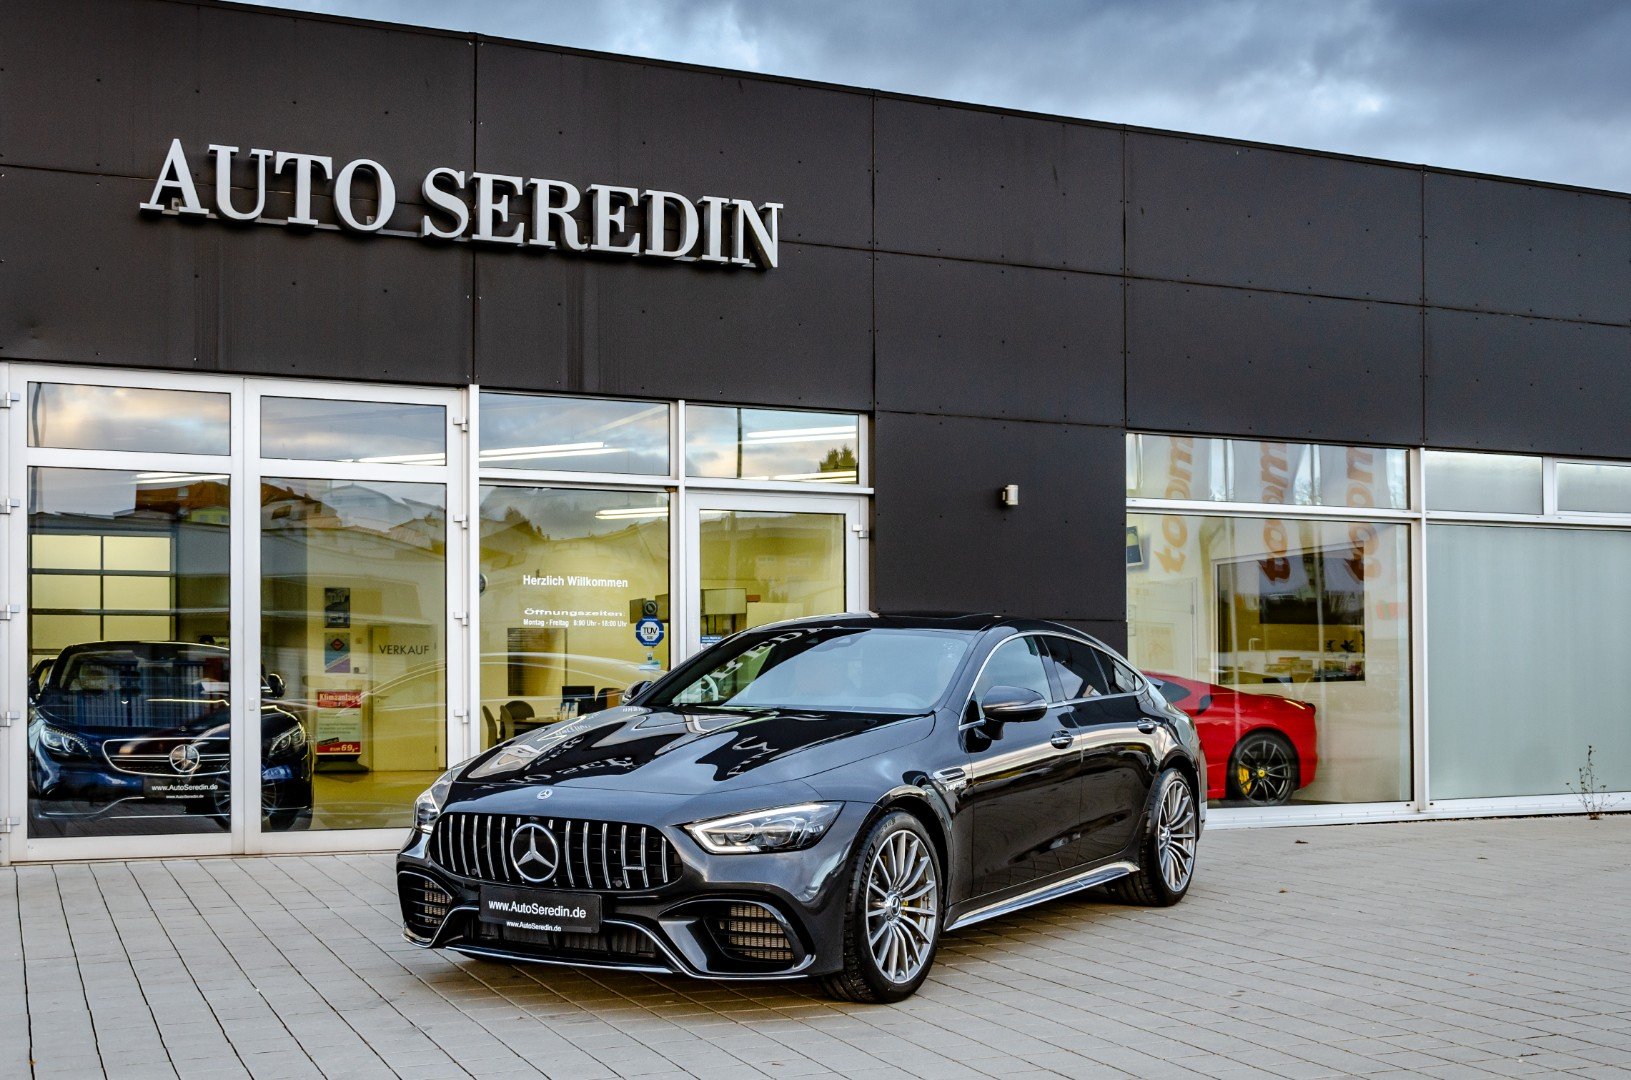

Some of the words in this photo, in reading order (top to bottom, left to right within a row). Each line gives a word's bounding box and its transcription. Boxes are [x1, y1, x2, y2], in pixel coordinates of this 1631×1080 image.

[139, 138, 396, 232] AUTO
[421, 167, 784, 269] SEREDIN
[522, 574, 565, 587] Herzlich
[567, 575, 629, 588] Willkommen
[523, 618, 545, 627] Montag
[549, 618, 570, 628] Freitag
[586, 619, 598, 627] Uhr
[616, 620, 628, 628] Uhr
[378, 644, 430, 655] VERKAUF
[151, 783, 219, 791] www.AutoSeredin.de
[488, 900, 587, 919] www.AutoSeredin.de
[506, 920, 562, 932] www.AutoSeredin.de
